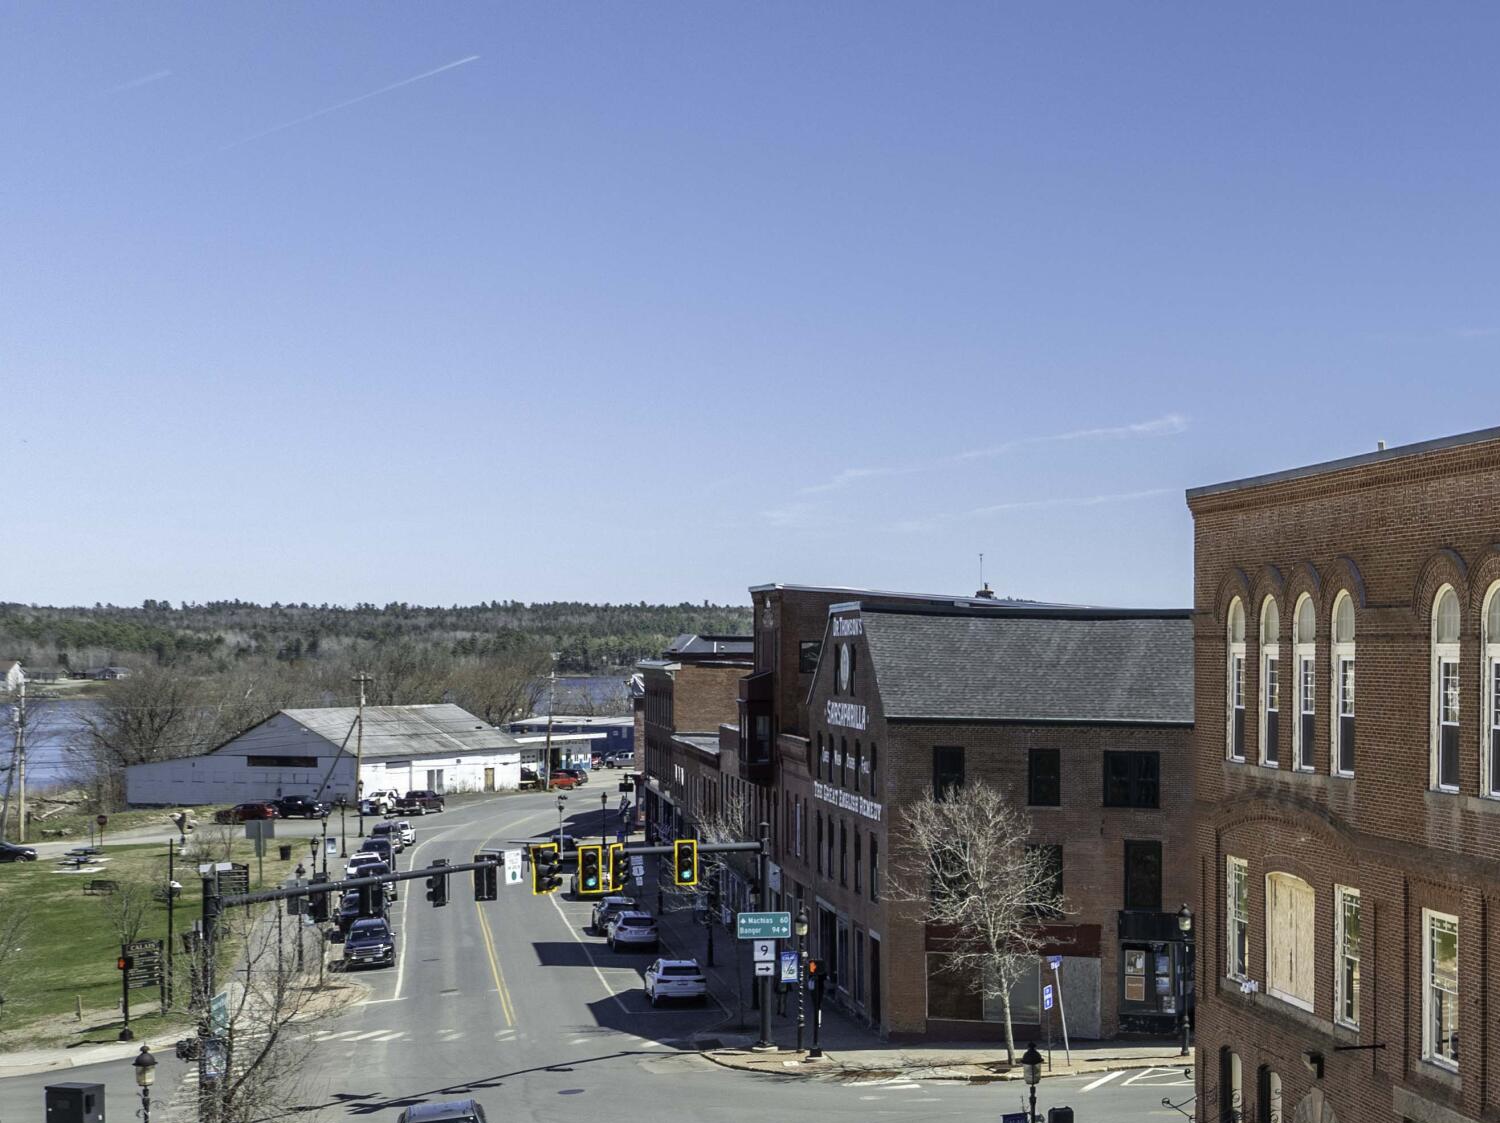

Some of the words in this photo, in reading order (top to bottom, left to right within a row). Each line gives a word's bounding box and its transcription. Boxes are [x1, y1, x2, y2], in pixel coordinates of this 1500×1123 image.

[748, 917, 774, 925] Machias
[780, 916, 788, 924] 60
[740, 926, 762, 936] Bangor
[772, 926, 780, 934] 94
[760, 945, 769, 956] 9
